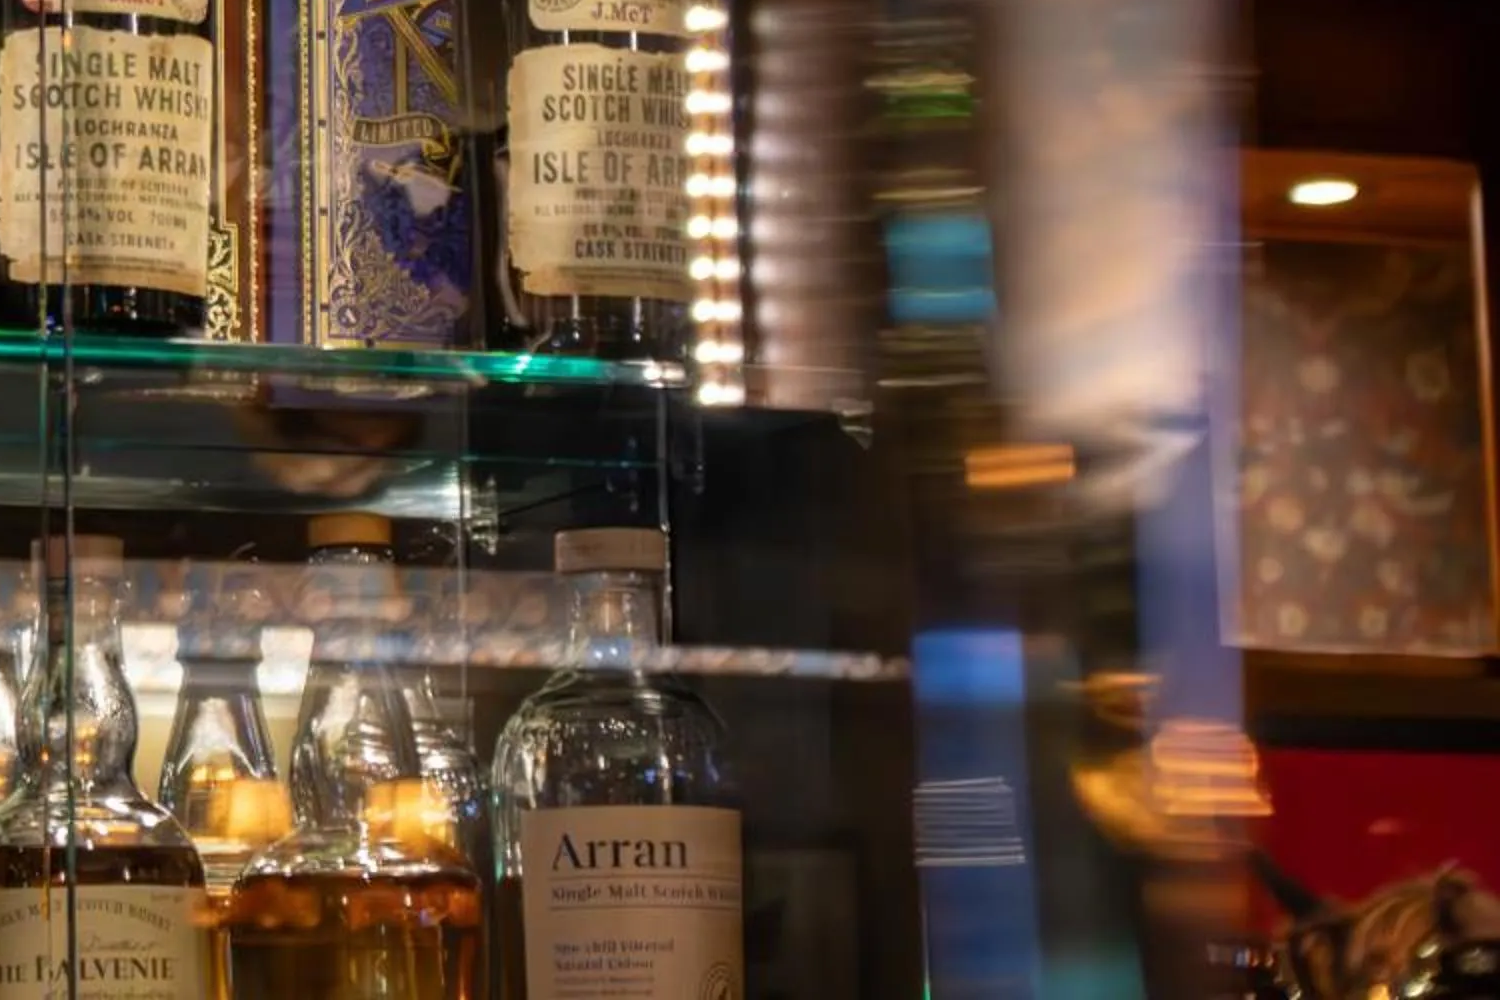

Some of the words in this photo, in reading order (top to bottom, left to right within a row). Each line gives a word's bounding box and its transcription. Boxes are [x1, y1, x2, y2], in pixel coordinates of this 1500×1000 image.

[149, 55, 202, 87] MALT
[562, 62, 639, 93] SINGLE
[12, 80, 123, 111] SCOTCH
[541, 95, 631, 123] SCOTCH
[73, 118, 179, 142] LOCHRANZA
[360, 118, 434, 143] LIMITED
[14, 142, 78, 172] ISLE
[89, 142, 127, 169] OF
[533, 151, 590, 184] ISLE
[603, 151, 635, 184] OF
[551, 831, 690, 873] Arran
[551, 884, 602, 904] Single
[607, 883, 647, 900] Malt
